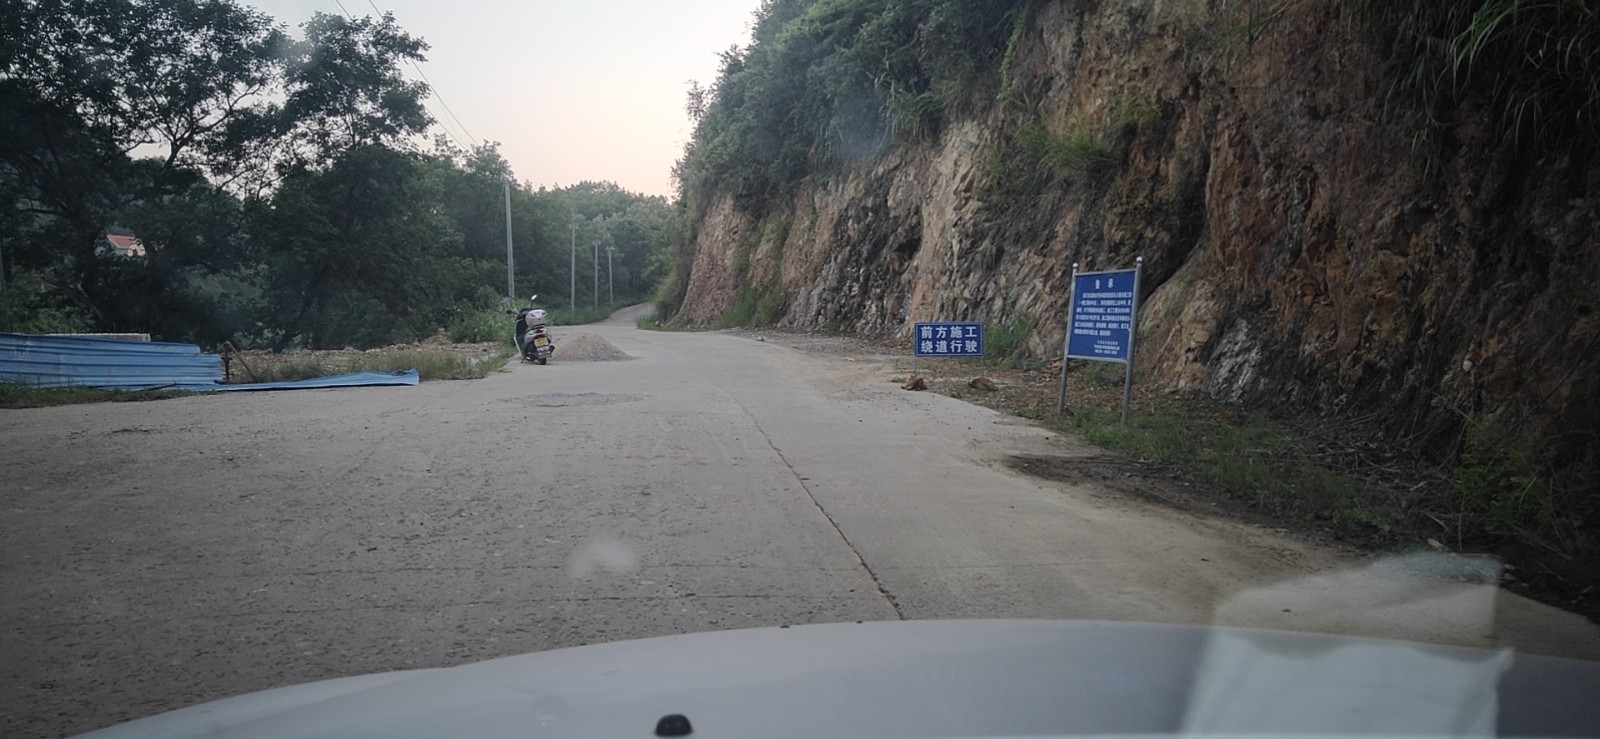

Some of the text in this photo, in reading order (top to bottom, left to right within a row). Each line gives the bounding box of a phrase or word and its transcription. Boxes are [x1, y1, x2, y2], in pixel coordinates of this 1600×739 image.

[920, 325, 977, 339] 前方施工
[920, 340, 978, 353] 绕道行驶
